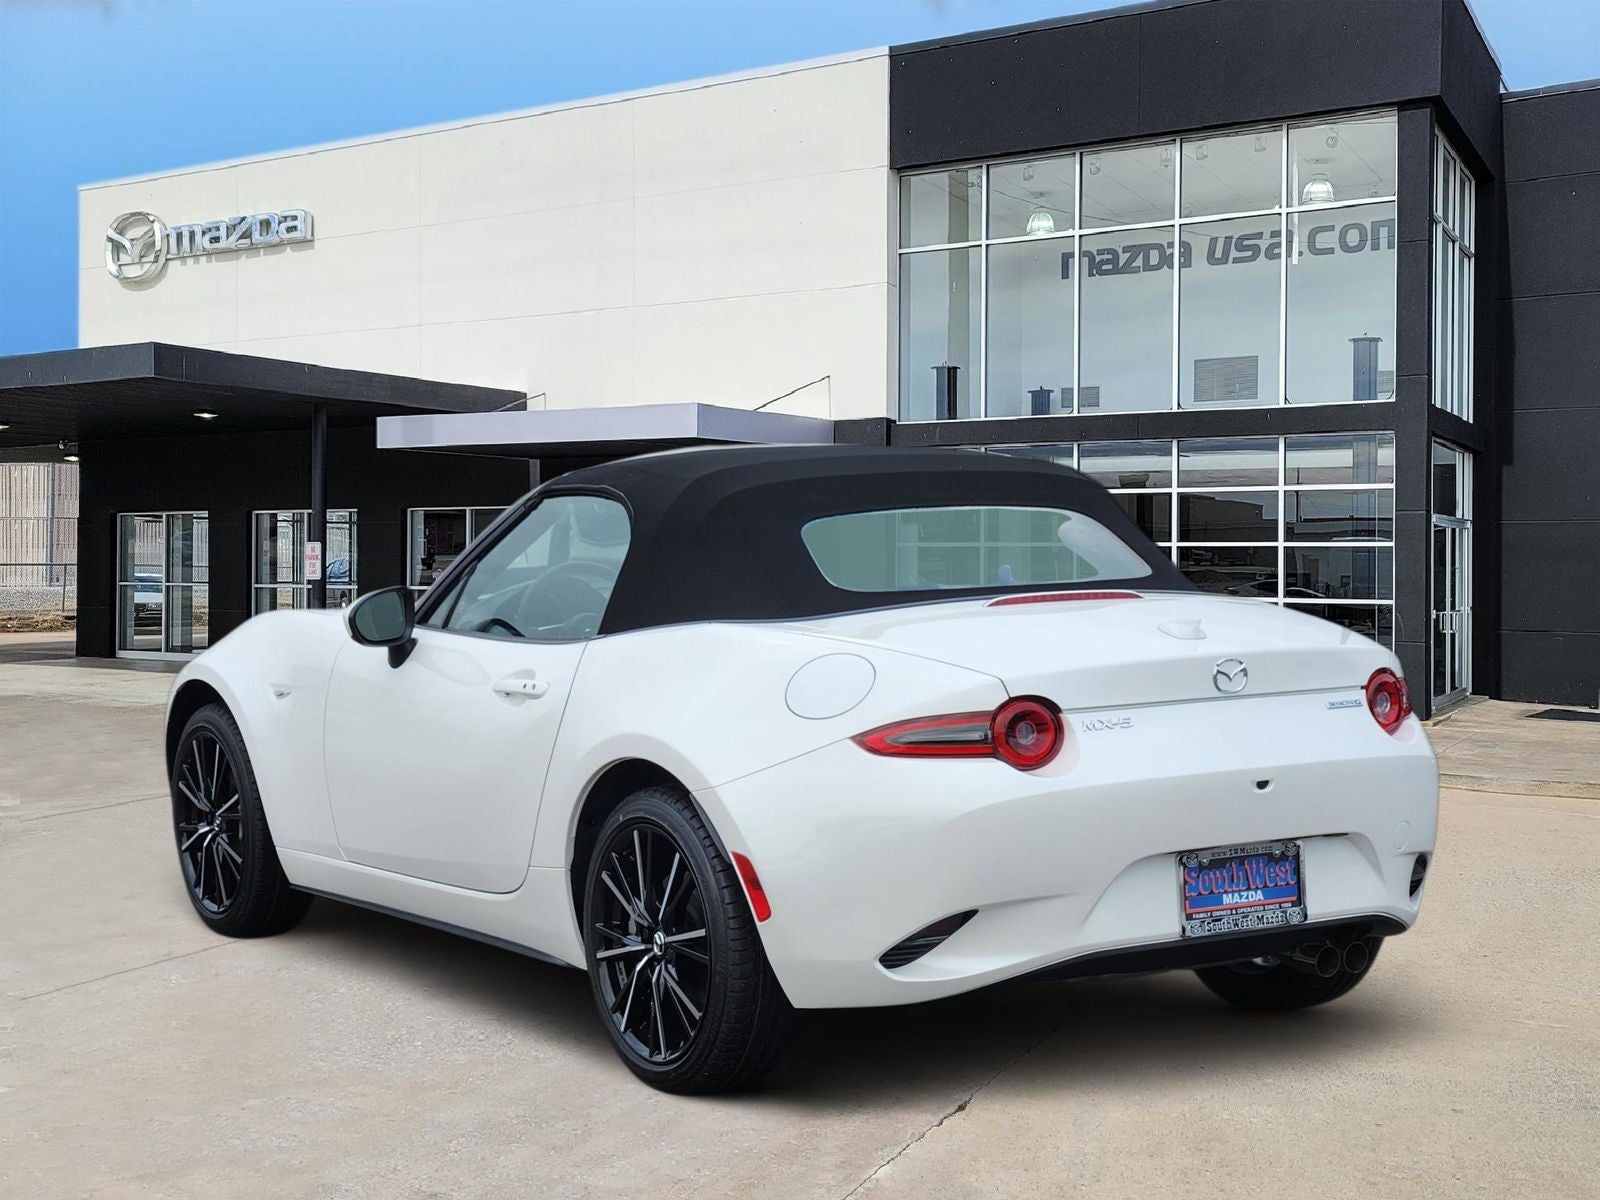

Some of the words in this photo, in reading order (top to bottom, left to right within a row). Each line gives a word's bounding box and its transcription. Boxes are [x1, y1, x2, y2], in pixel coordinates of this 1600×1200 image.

[166, 208, 311, 256] mazda
[1061, 238, 1192, 280] mazda
[1081, 717, 1134, 732] MX-5
[1222, 889, 1264, 905] MAZDA
[1192, 910, 1212, 919] FAMILY
[1212, 908, 1231, 917] OWNED
[1232, 907, 1237, 915] &
[1237, 905, 1264, 914] OPERATED
[1265, 903, 1280, 911] SINCE
[1206, 916, 1254, 933] SouthWest
[1255, 912, 1286, 928] Mazda
